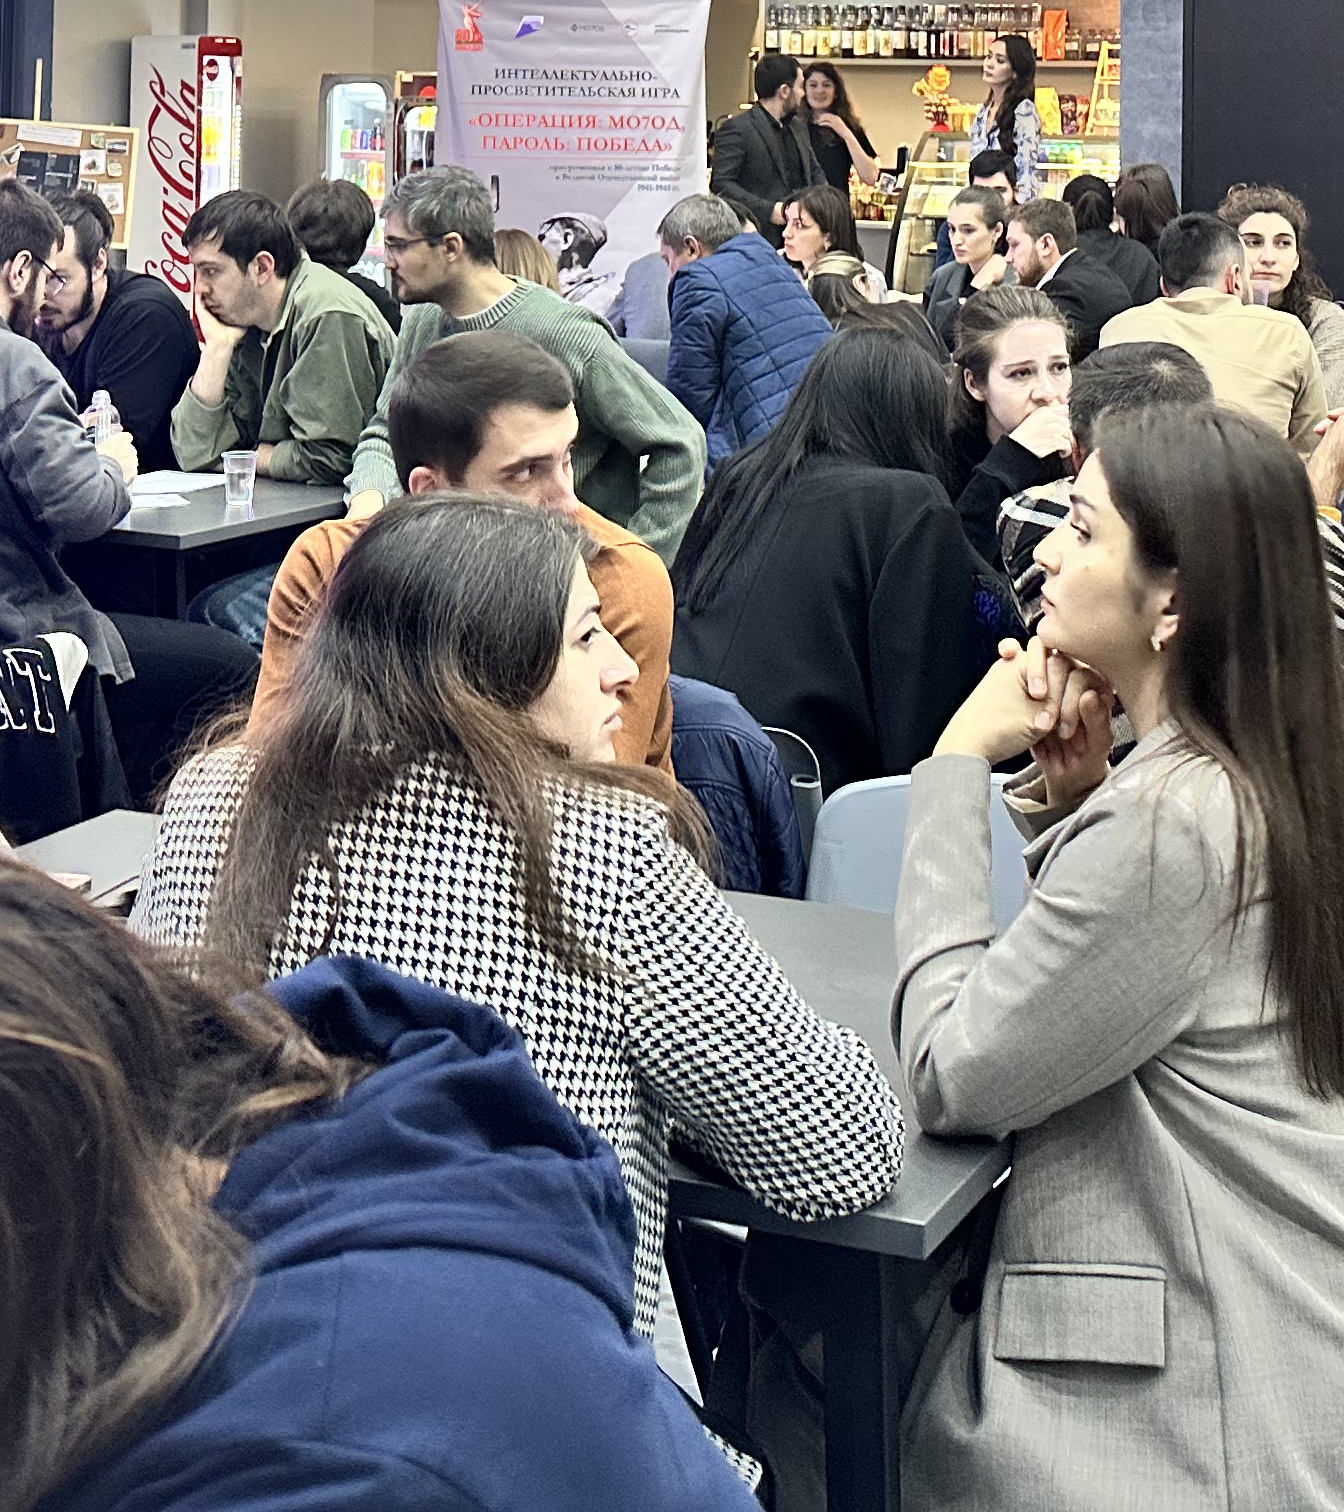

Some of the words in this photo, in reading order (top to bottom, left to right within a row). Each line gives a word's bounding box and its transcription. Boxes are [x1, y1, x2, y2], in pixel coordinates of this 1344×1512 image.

[494, 68, 658, 81] ИНТЕЛЛЕКТУАЛЬНО-
[471, 84, 636, 98] ПРОСВЕТИТЕЛЬСКАЯ
[641, 87, 681, 98] ИГРА
[468, 113, 602, 129] «ОПЕРАЦИЯ:
[481, 136, 570, 151] ПАРОЛЬ:
[577, 137, 672, 153] ПОБЕДА»
